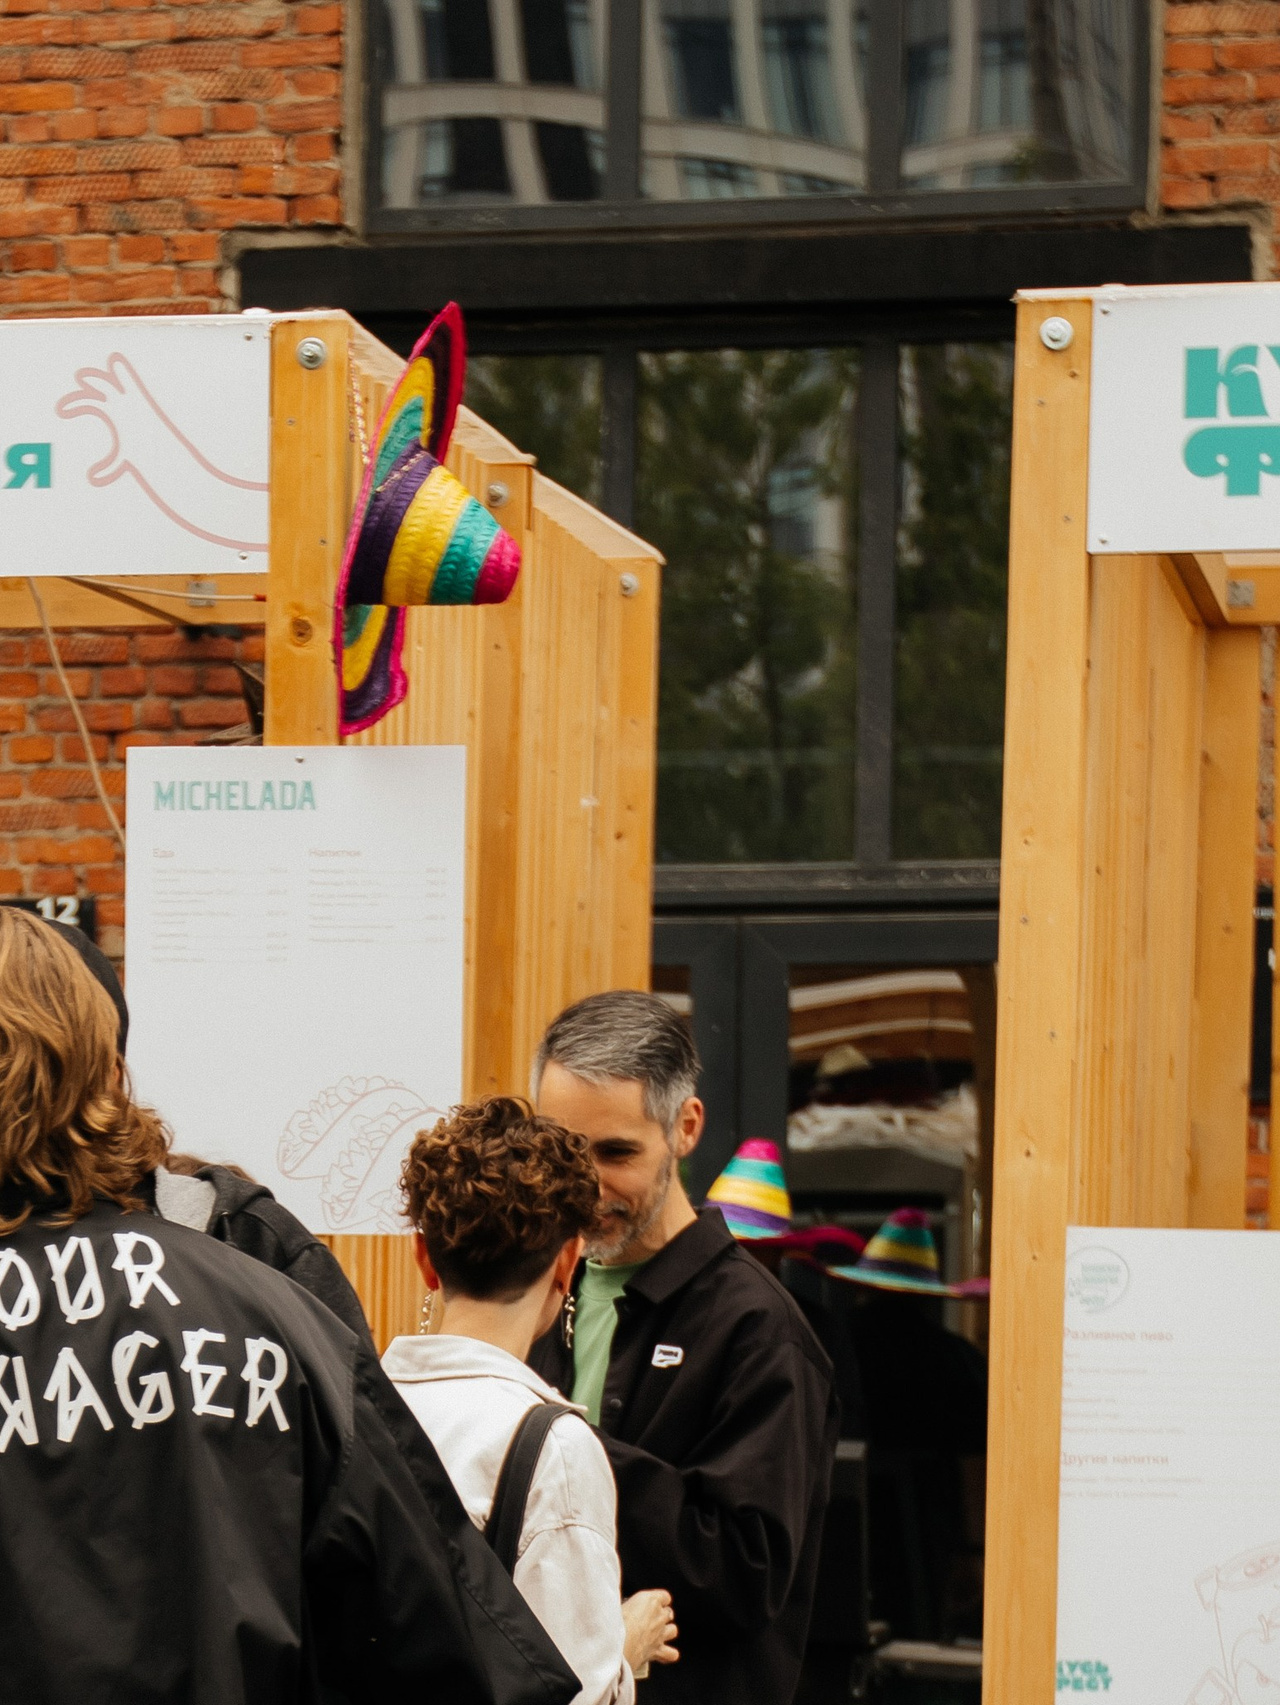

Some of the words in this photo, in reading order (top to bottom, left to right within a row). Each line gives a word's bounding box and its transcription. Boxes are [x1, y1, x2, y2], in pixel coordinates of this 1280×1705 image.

[1184, 343, 1280, 418] К
[153, 780, 317, 811] MICHELADA
[36, 896, 80, 925] 12
